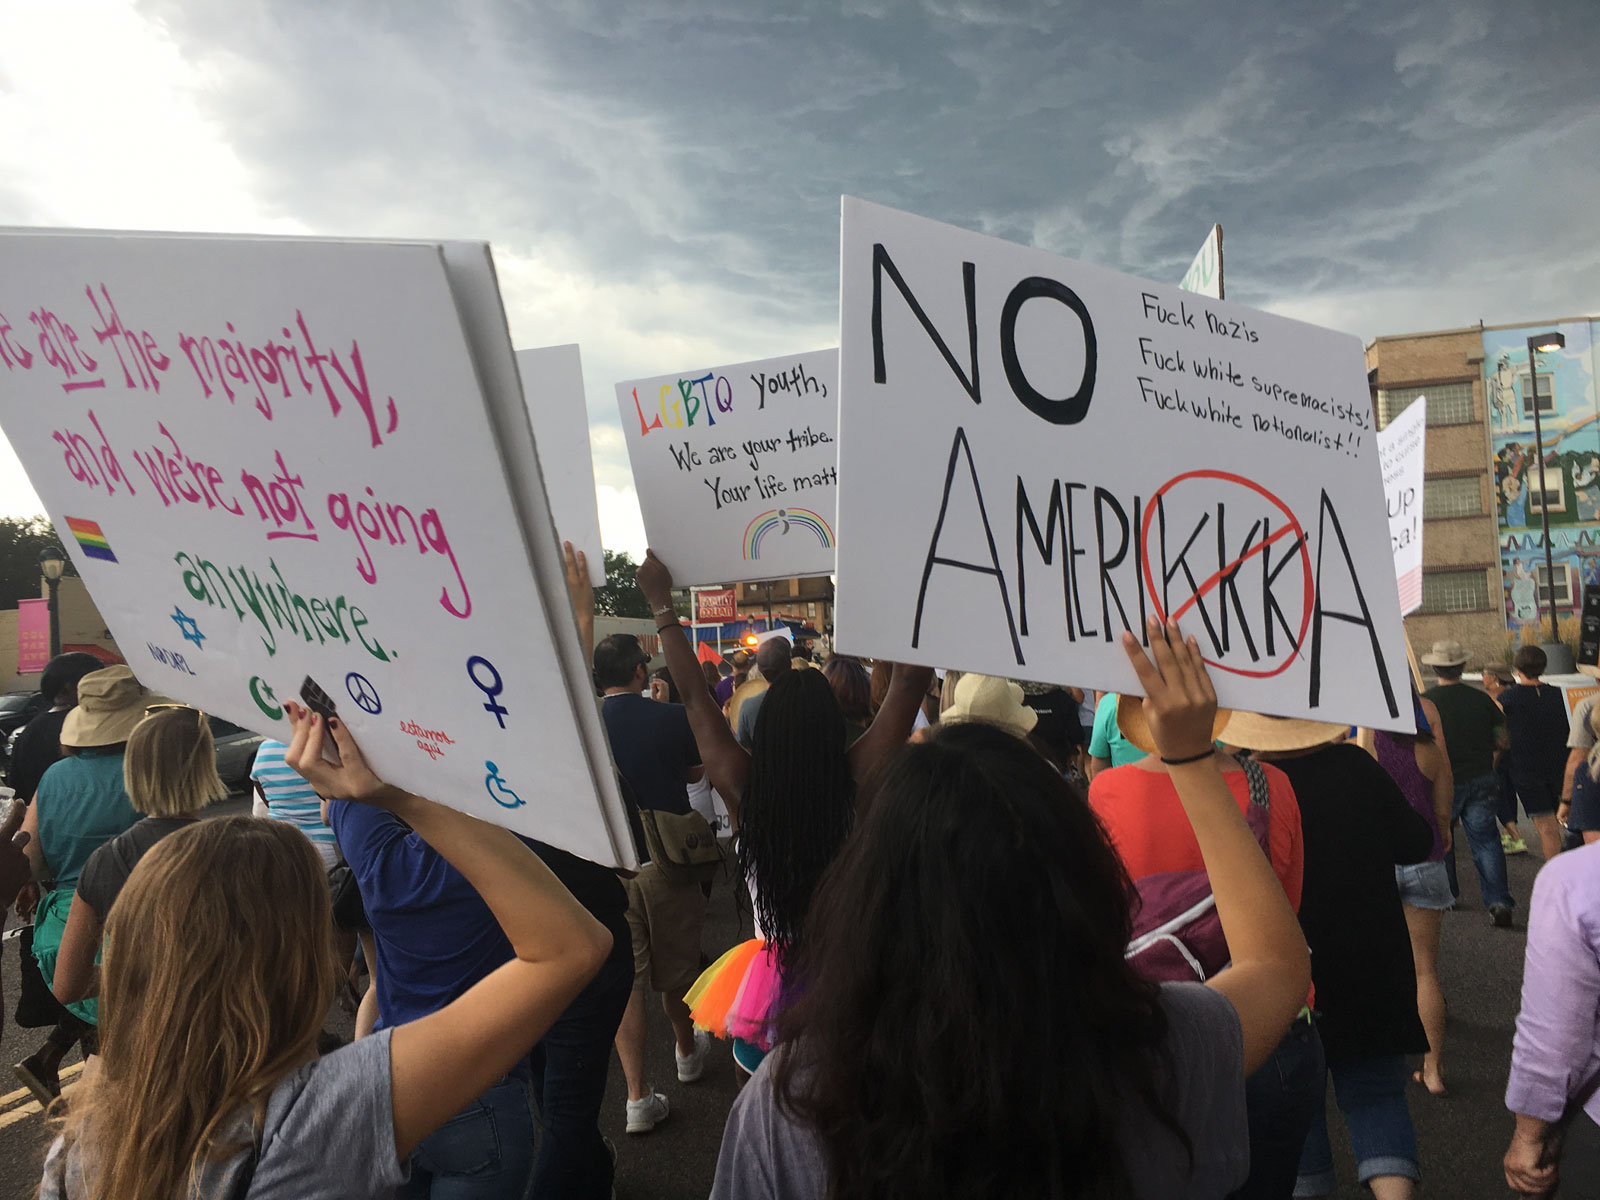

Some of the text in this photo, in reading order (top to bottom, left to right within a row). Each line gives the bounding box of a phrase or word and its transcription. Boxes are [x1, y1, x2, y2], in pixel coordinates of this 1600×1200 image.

[872, 243, 1097, 426] NO
[1141, 292, 1195, 330] Fuck
[30, 306, 98, 379] are
[87, 282, 170, 394] the
[179, 308, 398, 447] majority,
[632, 363, 827, 436] LGBTQ youth,
[1137, 376, 1187, 411] Fuck
[1192, 397, 1243, 428] white
[1138, 337, 1370, 430] Fuck white supremacists!
[669, 426, 833, 472] We are your tribe.
[704, 476, 751, 510] Your
[754, 474, 787, 500] life
[52, 409, 472, 619] and we're not going
[174, 550, 398, 662] anywhere.
[912, 427, 1399, 719] AMERIKKKA
